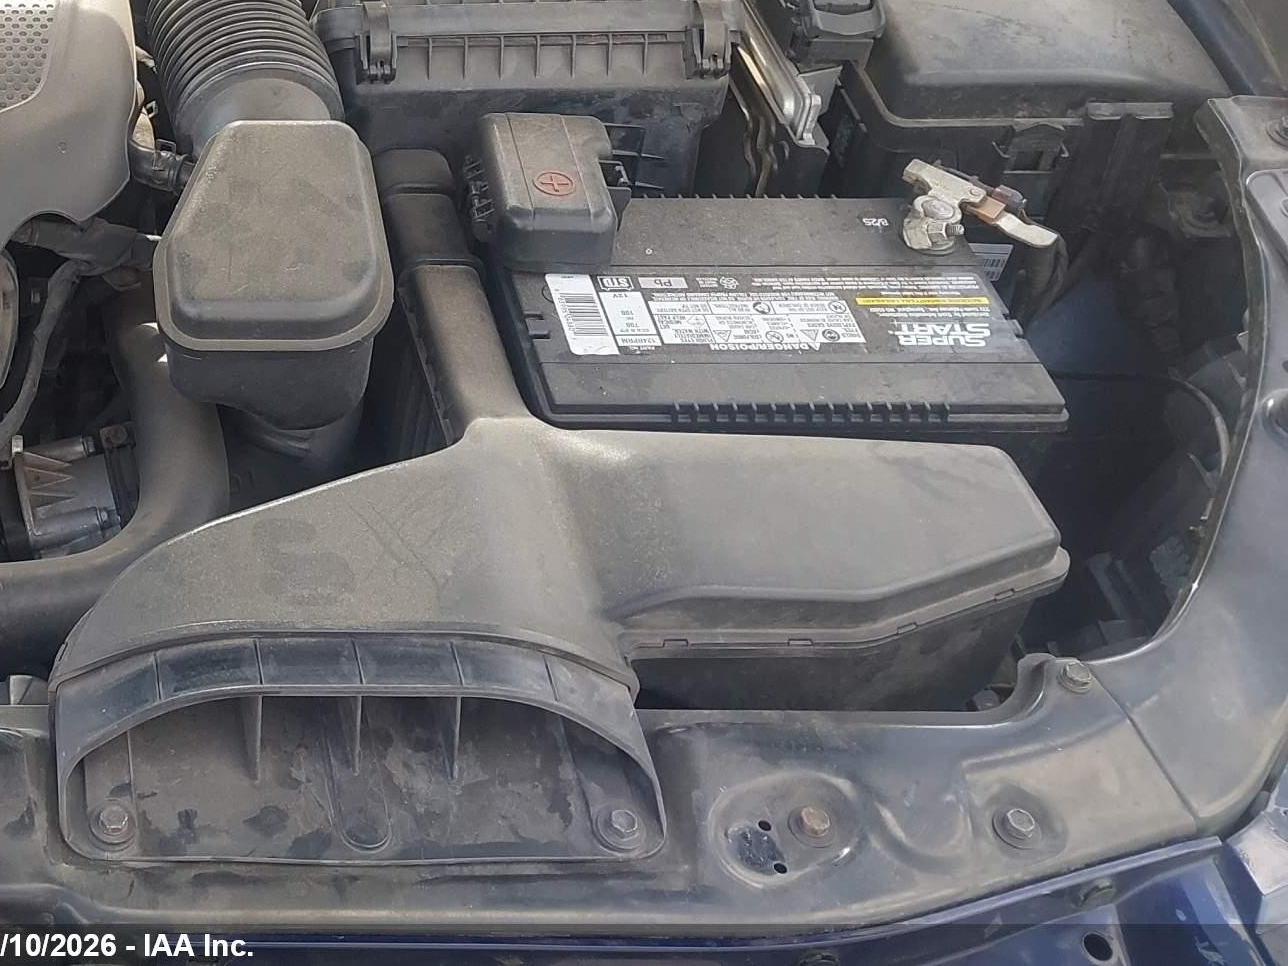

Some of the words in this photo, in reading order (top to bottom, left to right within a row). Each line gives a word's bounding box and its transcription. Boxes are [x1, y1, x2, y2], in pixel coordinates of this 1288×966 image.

[654, 278, 672, 286] Pb
[894, 323, 990, 336] START
[898, 335, 986, 346] SUPER
